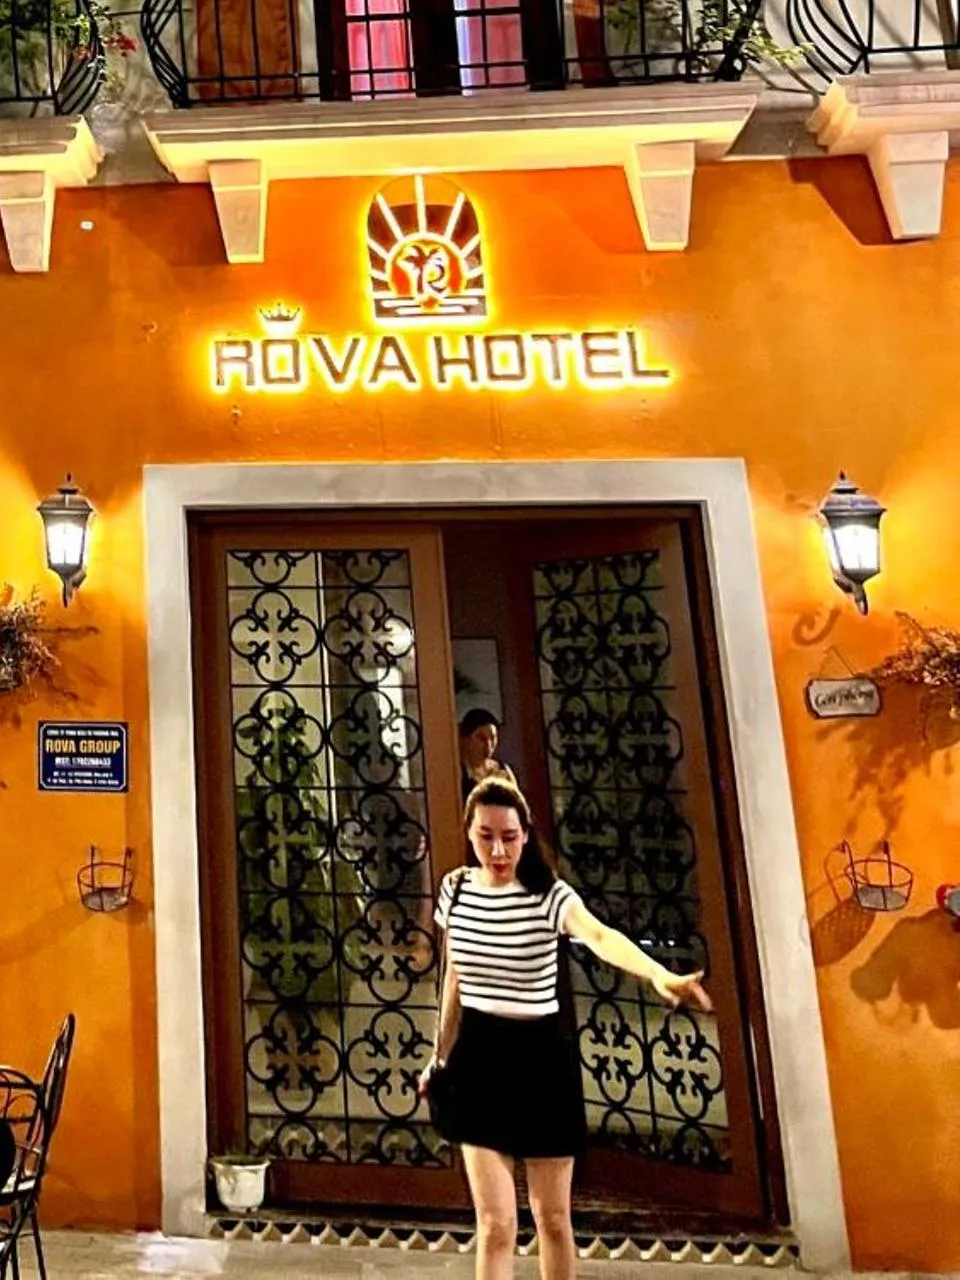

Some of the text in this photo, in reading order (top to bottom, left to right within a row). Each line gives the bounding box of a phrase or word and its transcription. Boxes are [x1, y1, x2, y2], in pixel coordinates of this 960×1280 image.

[214, 325, 671, 387] ROVA HOTEL
[45, 739, 121, 754] ROVA GROUP
